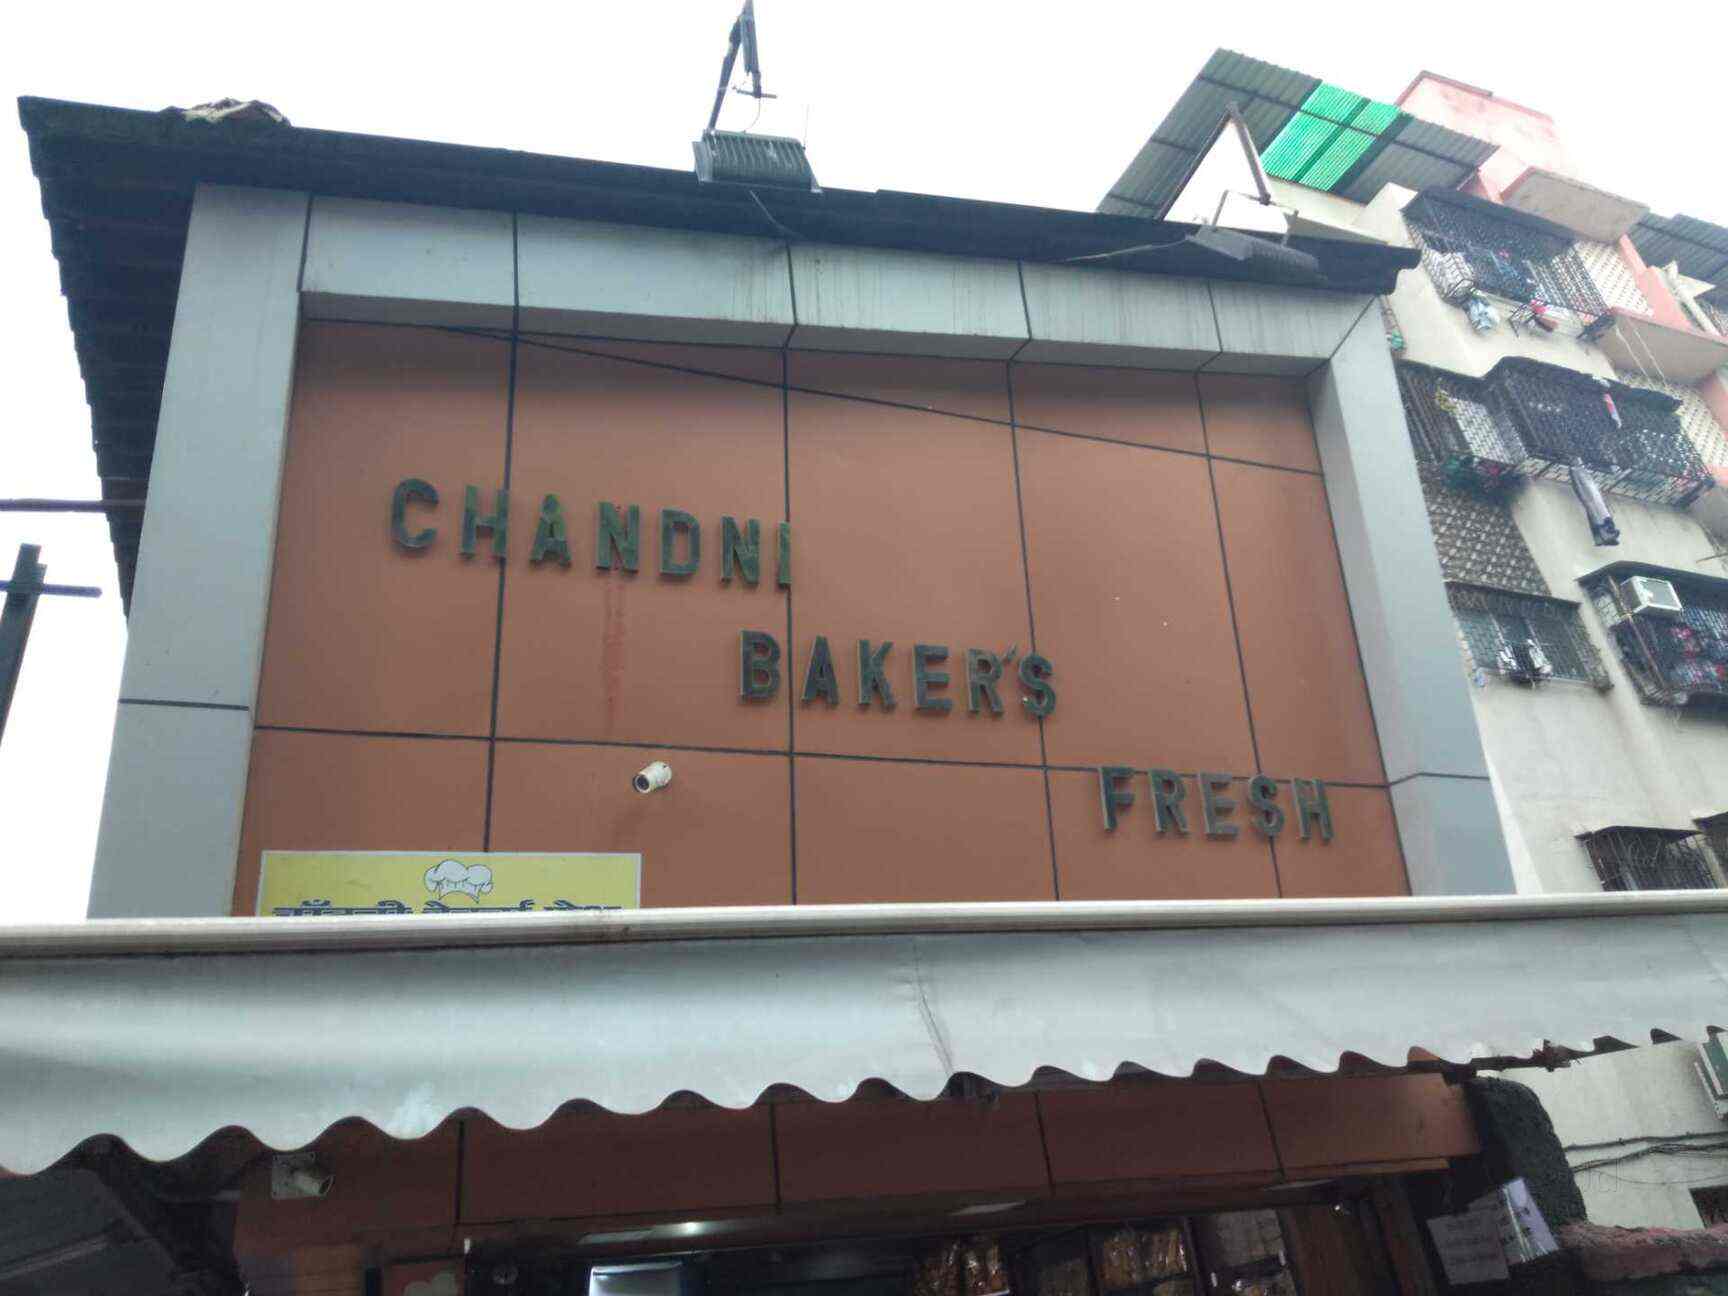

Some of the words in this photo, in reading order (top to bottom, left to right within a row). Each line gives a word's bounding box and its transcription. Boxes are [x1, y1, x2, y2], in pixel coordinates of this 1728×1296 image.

[391, 478, 793, 586] CHANDNI
[738, 629, 1056, 717] BAKER'S
[1098, 766, 1334, 840] FRESH
